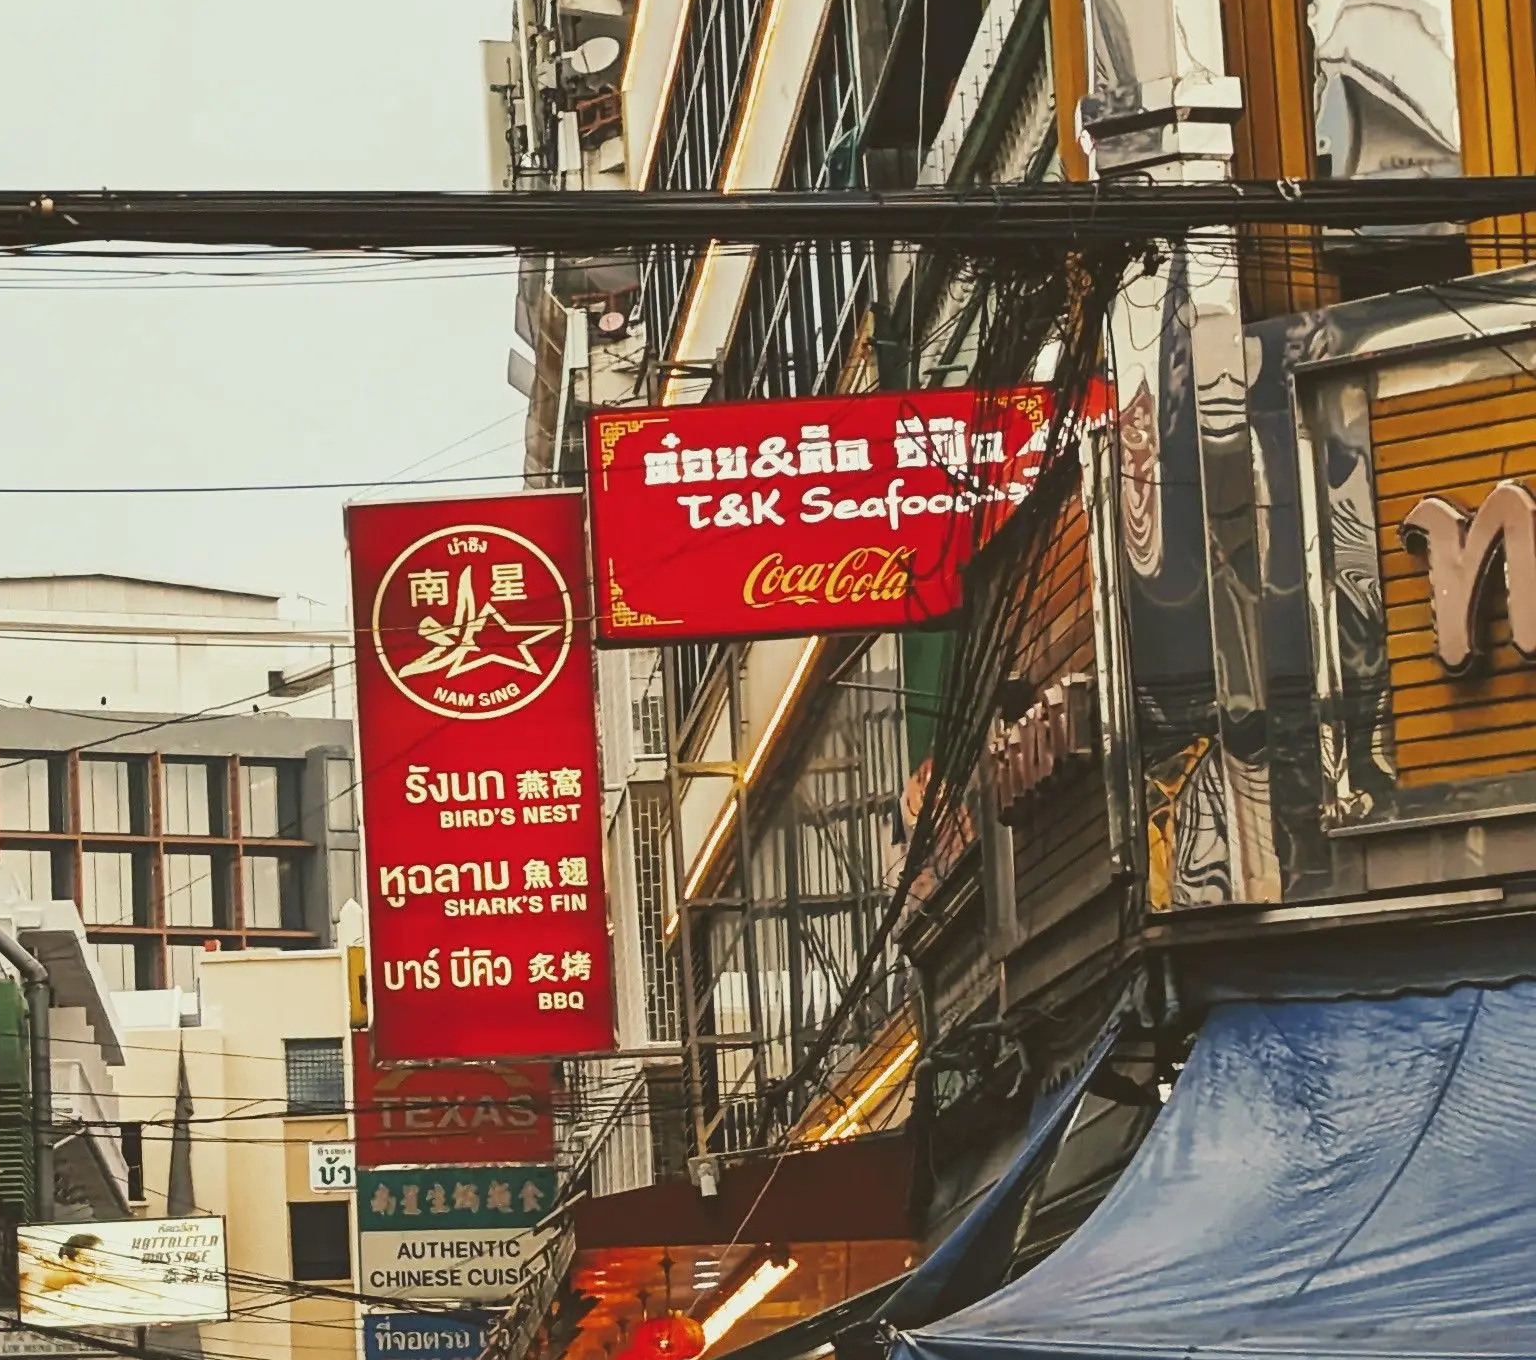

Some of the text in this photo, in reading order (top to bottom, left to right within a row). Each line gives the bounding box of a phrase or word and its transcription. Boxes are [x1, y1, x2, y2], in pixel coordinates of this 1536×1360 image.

[676, 488, 786, 530] T&K
[407, 563, 528, 608] 南 星
[742, 545, 917, 609] Coca-Cola
[433, 682, 521, 707] NAM SING
[405, 765, 582, 804] รังนก 燕窩
[440, 804, 581, 829] BIRD'S NEST
[379, 857, 588, 908] หูฉลาม 魚翅
[444, 893, 587, 917] SHARK'S FIN
[384, 948, 441, 990] บาร์
[450, 946, 512, 988] บีคิว
[538, 991, 584, 1010] BBQ
[372, 1095, 539, 1130] TEXAS
[397, 1240, 520, 1259] AUTHENTIC
[370, 1269, 462, 1288] CHINESE
